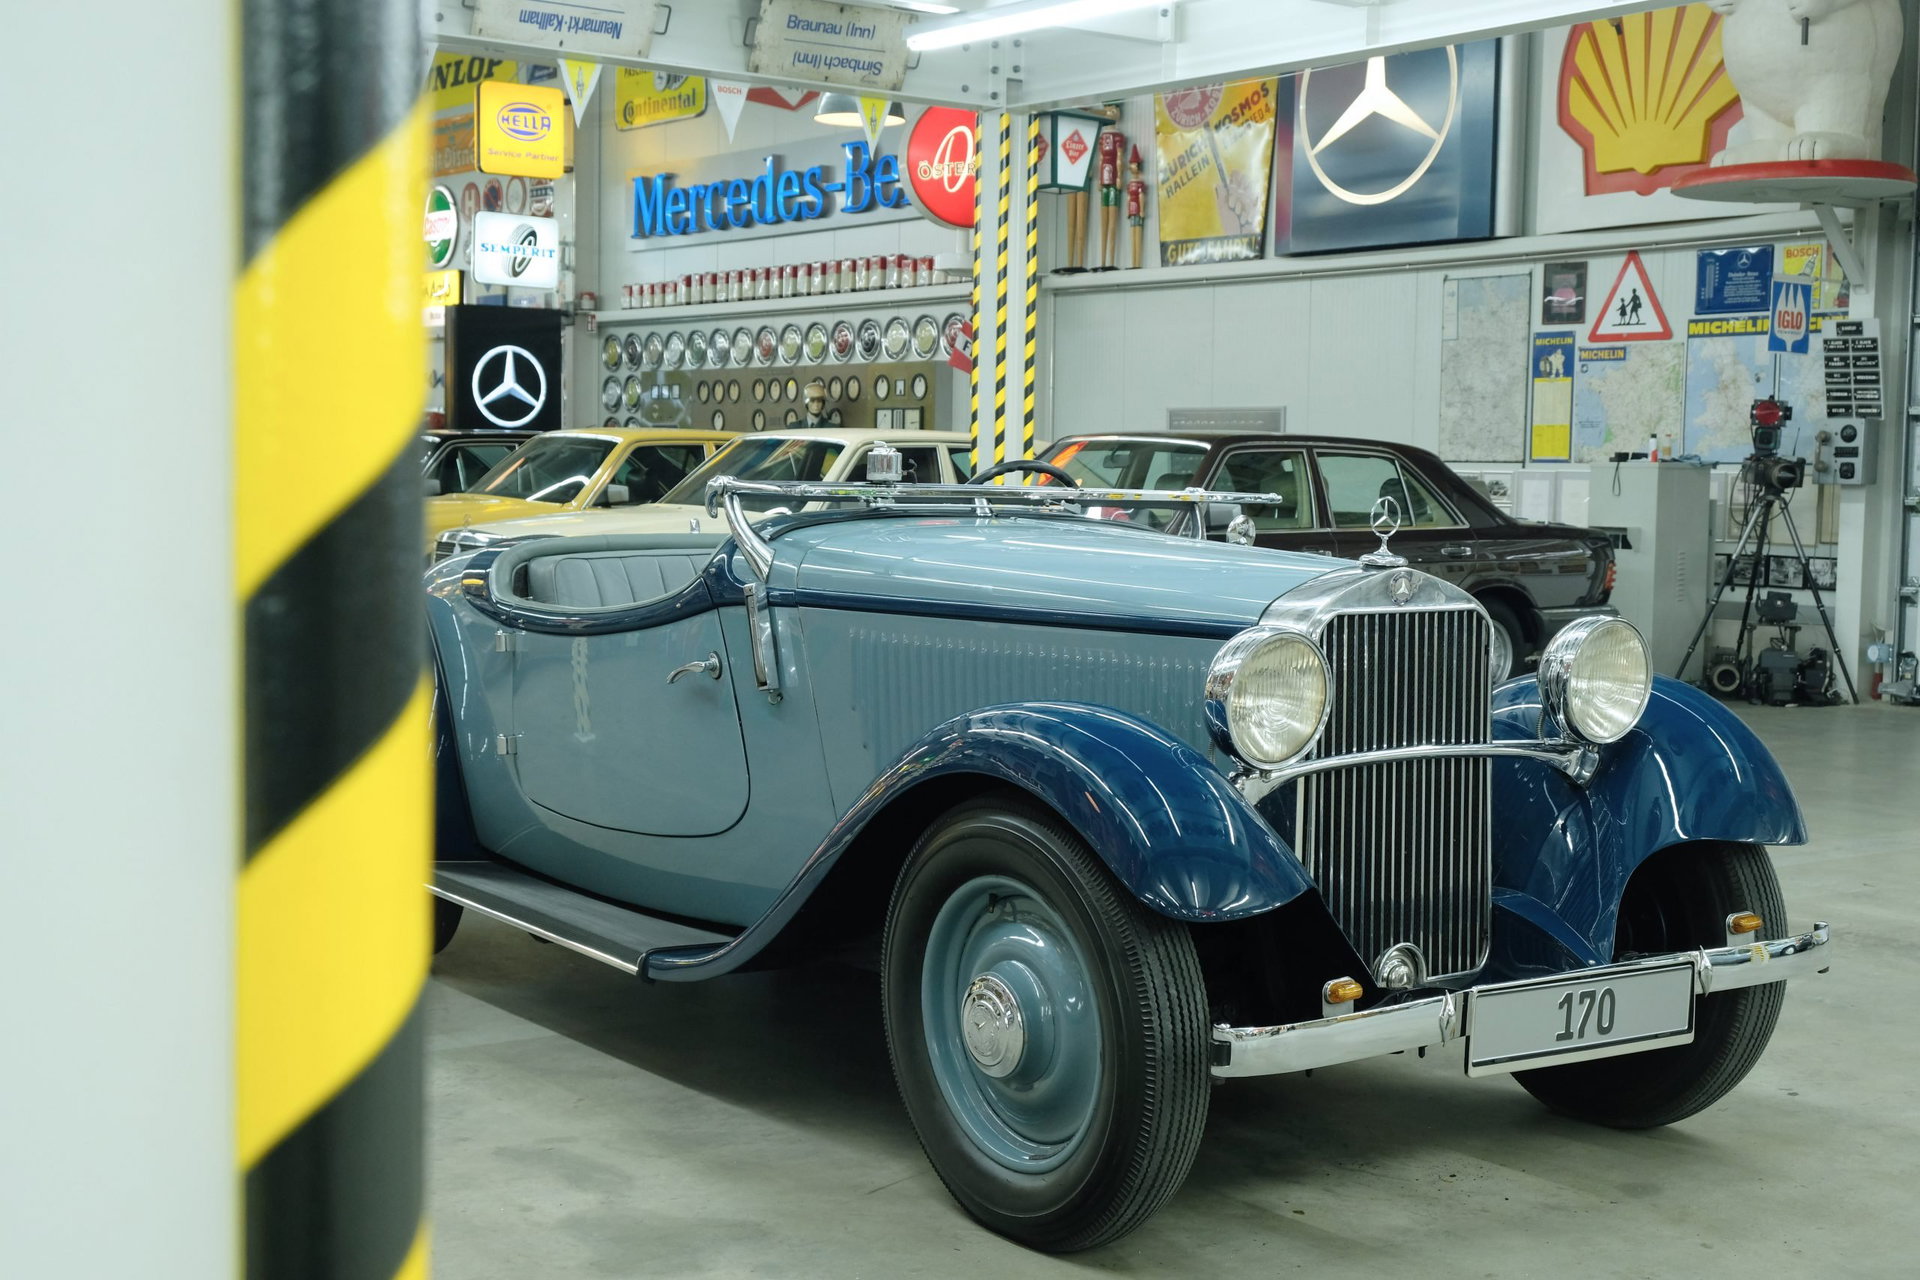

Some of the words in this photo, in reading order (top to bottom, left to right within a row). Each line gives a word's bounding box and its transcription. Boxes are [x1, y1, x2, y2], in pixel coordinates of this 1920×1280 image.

[787, 14, 842, 35] Braunau
[846, 22, 876, 40] (Inn)
[792, 51, 822, 70] (Inn)
[824, 55, 883, 75] Simbach
[717, 84, 742, 95] BOSCH
[623, 87, 697, 125] Continental
[501, 114, 551, 131] HELLA
[488, 148, 521, 158] Service
[525, 152, 559, 161] Partner
[1165, 153, 1211, 199] HALLEIN
[631, 140, 911, 239] Mercedes-Be
[480, 243, 556, 258] SEMPERIT
[1786, 247, 1819, 259] BOSCH
[1777, 310, 1803, 330] IGLO
[1535, 337, 1573, 346] MICHELIN
[1580, 350, 1625, 360] MICHELIN
[1556, 986, 1616, 1041] 170
